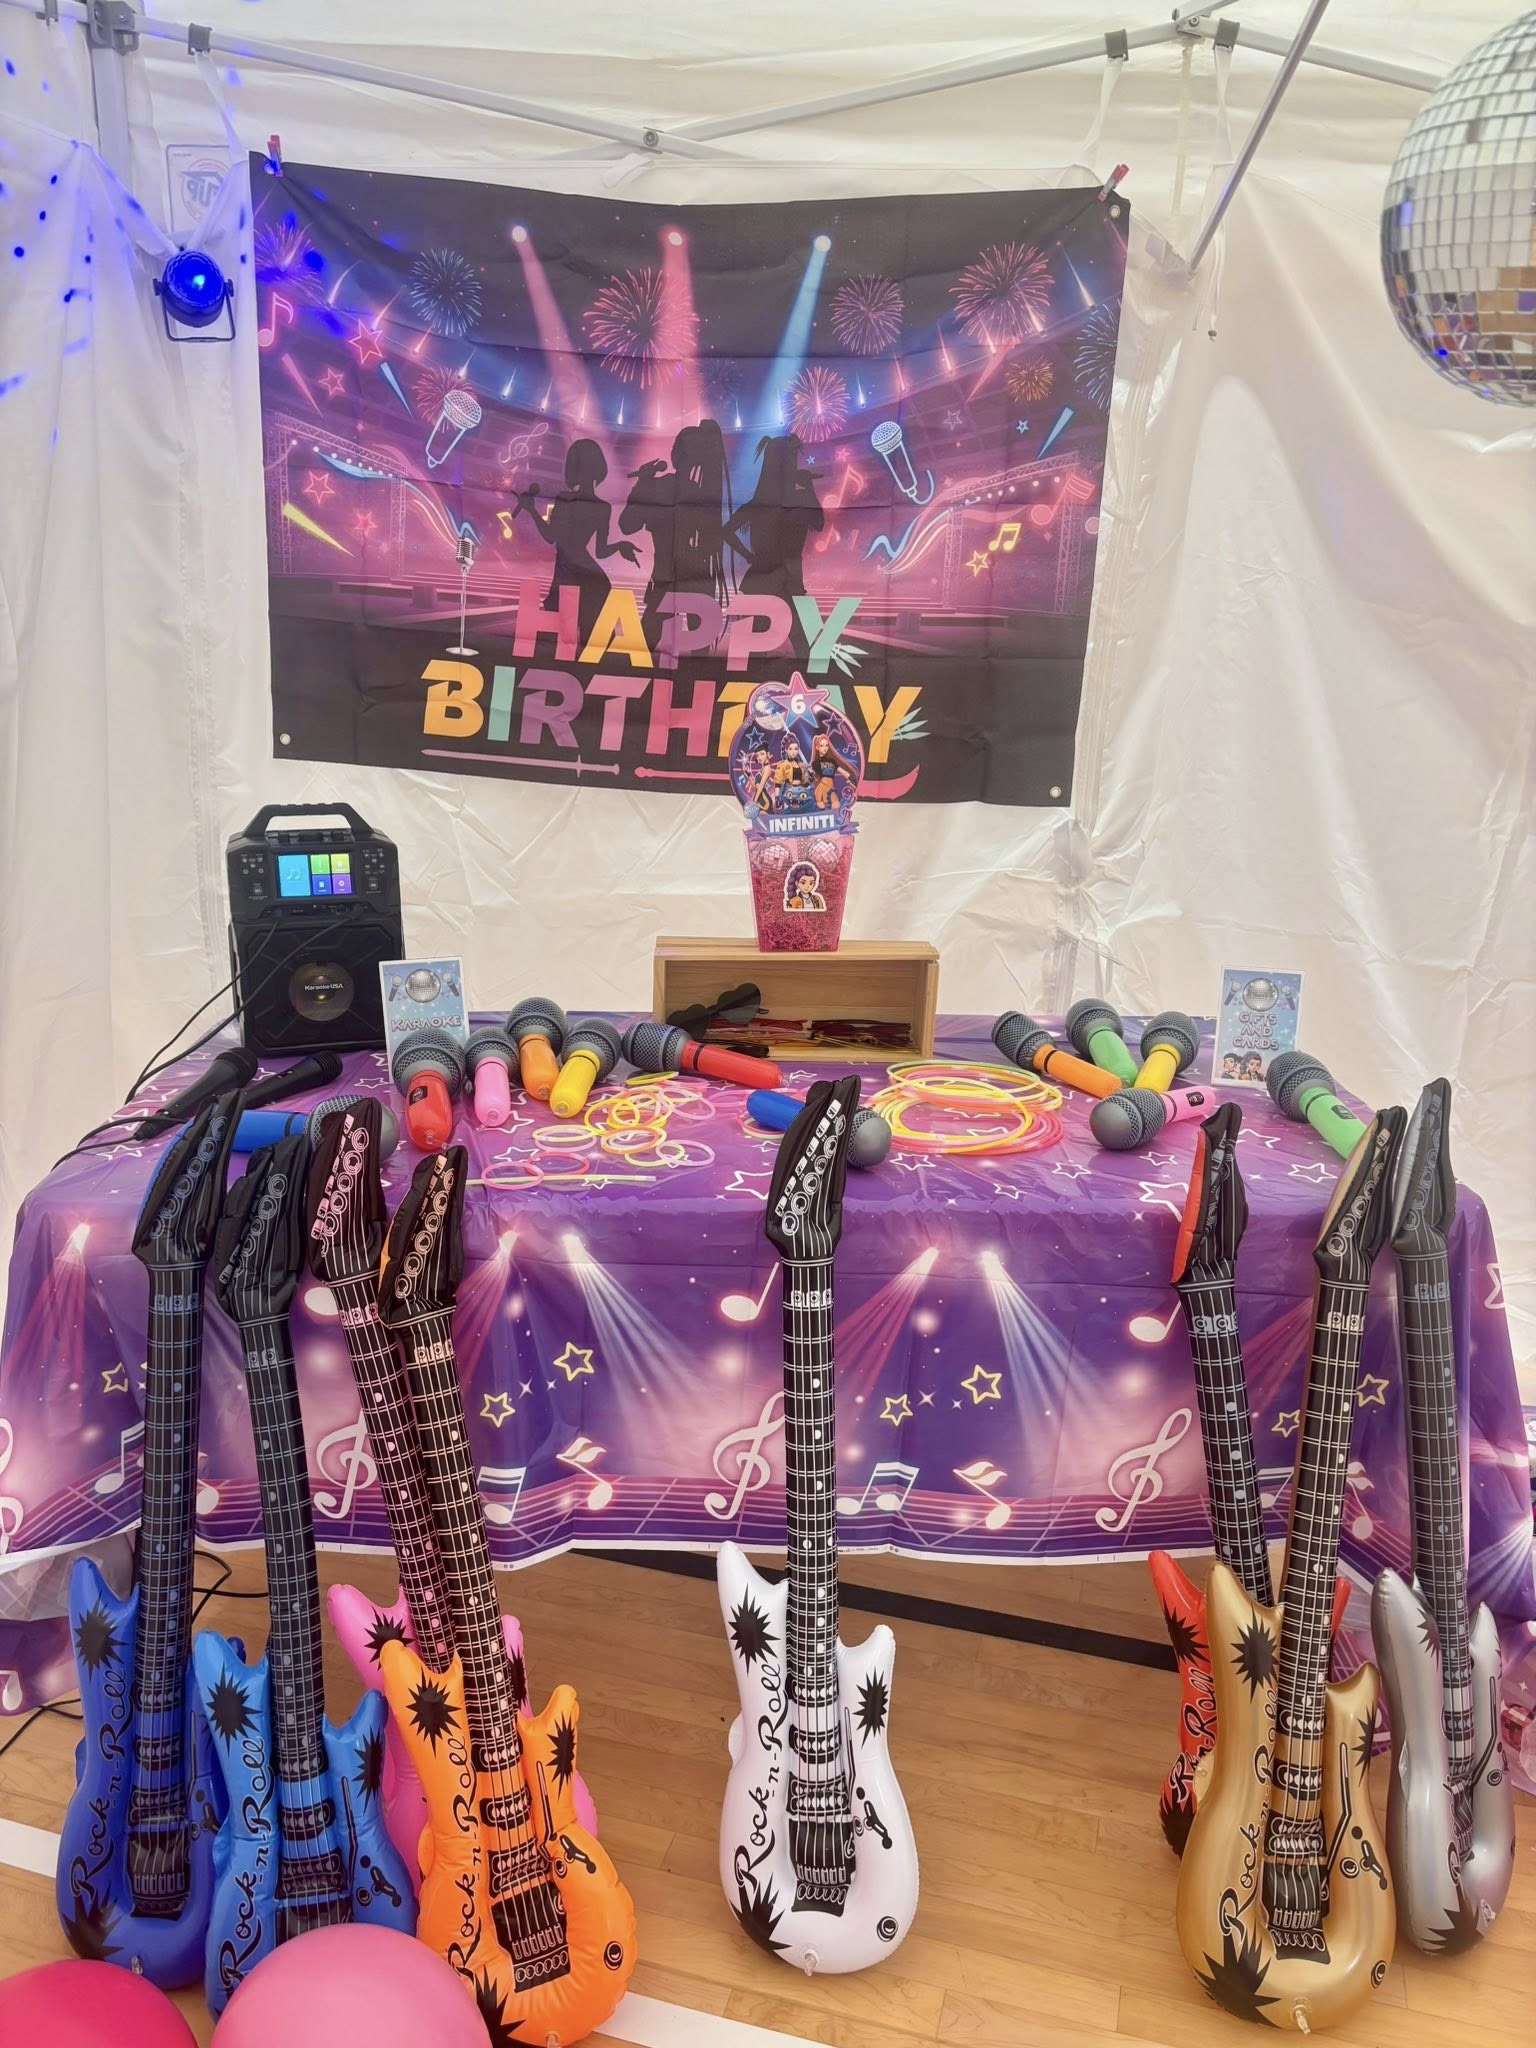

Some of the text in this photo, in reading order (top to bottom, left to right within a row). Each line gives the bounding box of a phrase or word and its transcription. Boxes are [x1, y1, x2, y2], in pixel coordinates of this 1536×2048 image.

[512, 583, 862, 674] HAPPY
[421, 659, 923, 764] BIRTHY
[790, 693, 805, 715] 6
[769, 814, 835, 834] INFINITI
[391, 1014, 463, 1032] KARAOKE
[1239, 1012, 1278, 1026] GIFTS
[1240, 1024, 1274, 1038] AND
[1232, 1036, 1280, 1050] CARDS
